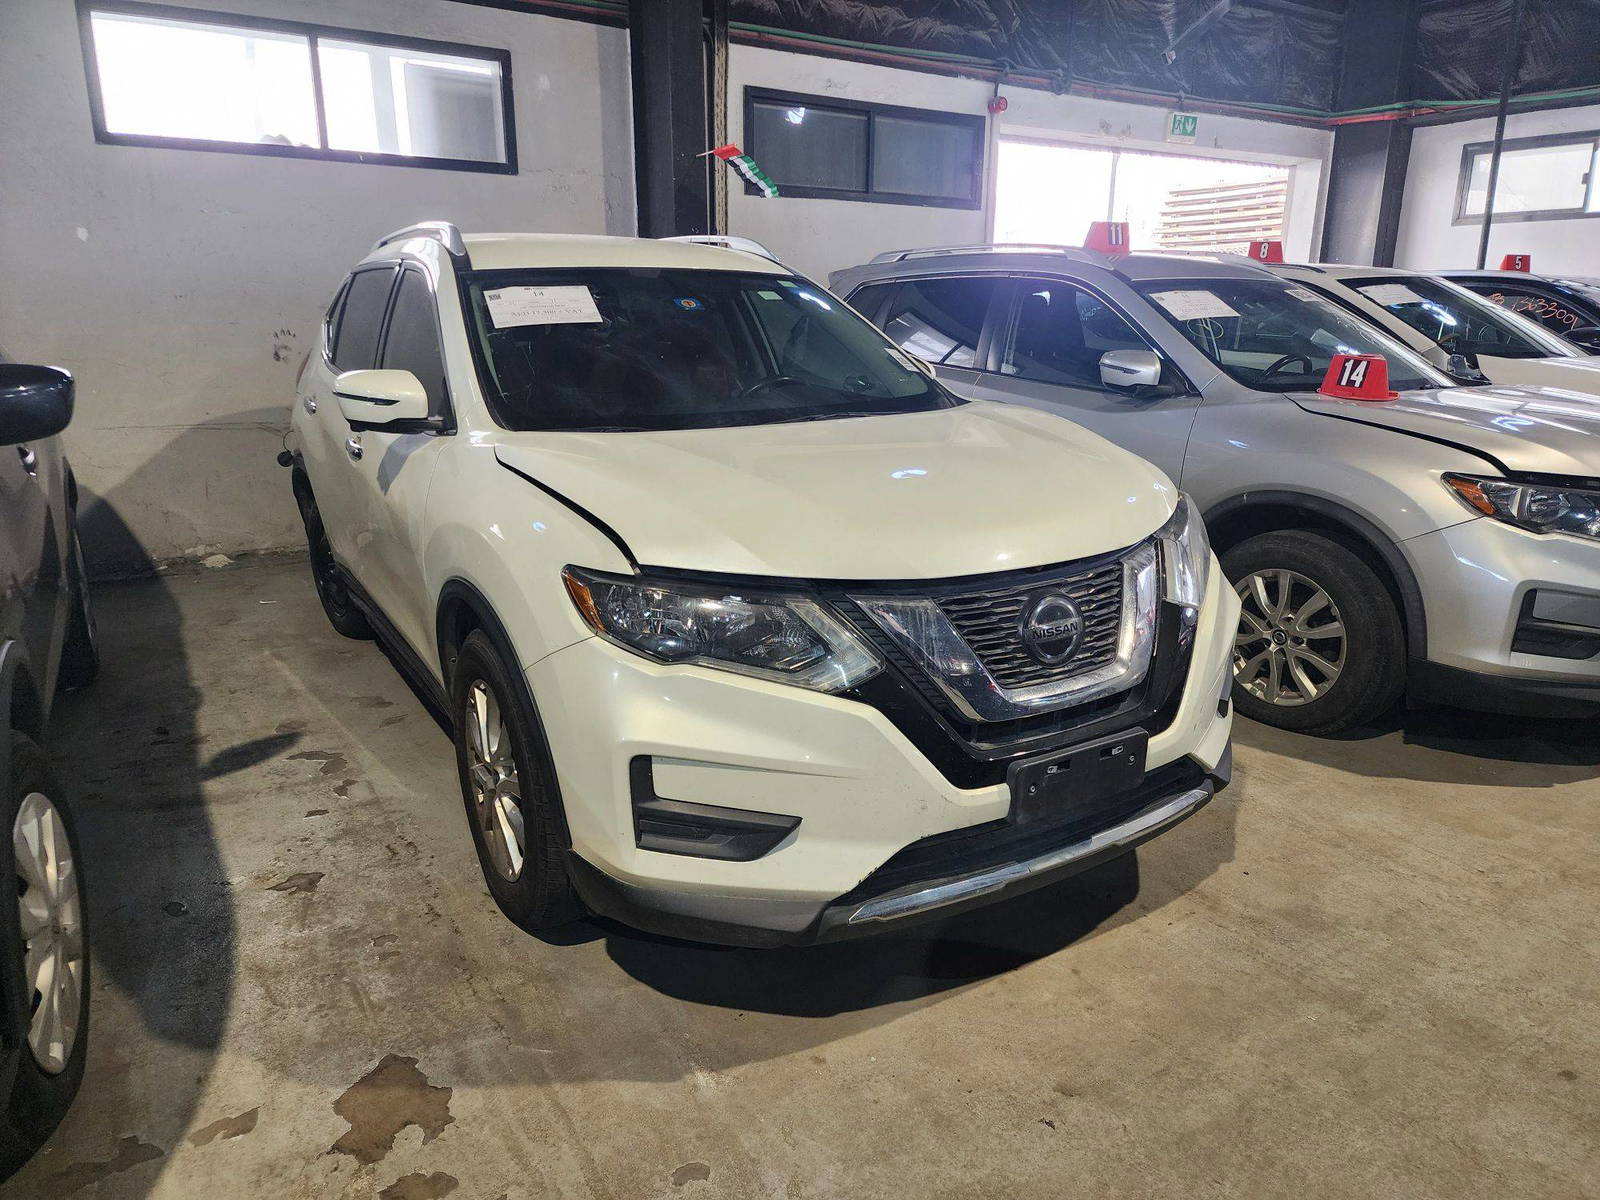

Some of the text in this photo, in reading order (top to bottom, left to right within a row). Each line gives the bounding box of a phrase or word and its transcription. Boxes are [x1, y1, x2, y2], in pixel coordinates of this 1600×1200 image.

[1111, 223, 1123, 245] 11
[1260, 242, 1269, 258] 8
[1515, 256, 1522, 270] 5
[1340, 359, 1368, 388] 14
[1032, 621, 1078, 639] NISSAN
